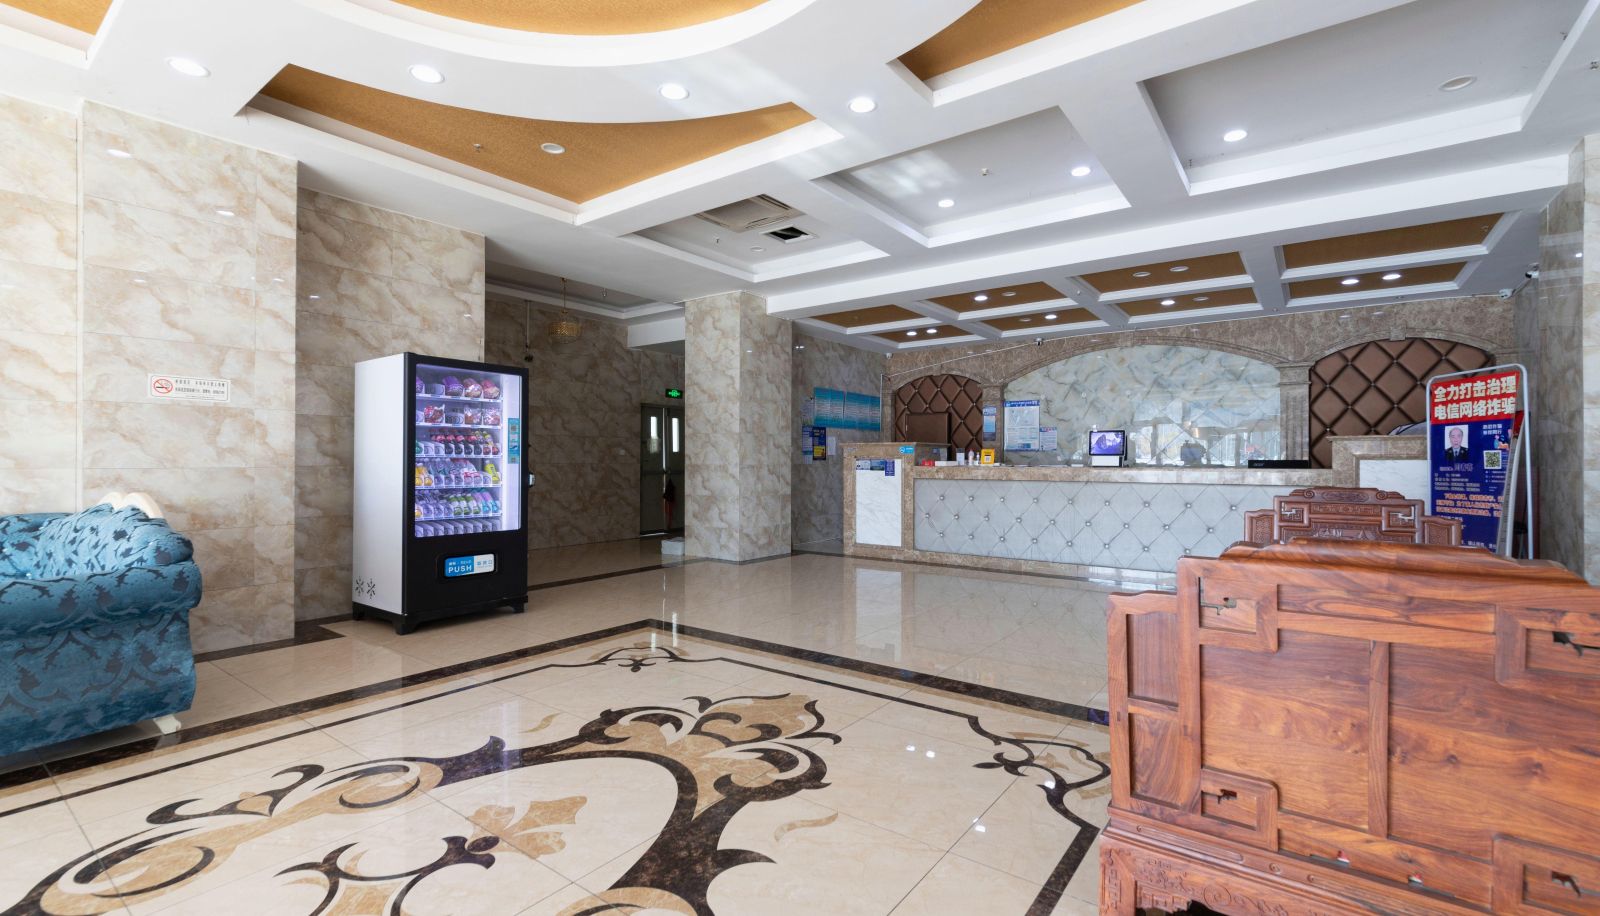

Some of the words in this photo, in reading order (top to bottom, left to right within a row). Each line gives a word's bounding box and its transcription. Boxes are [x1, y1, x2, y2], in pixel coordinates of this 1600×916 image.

[1434, 375, 1516, 402] 全力打击治理
[1434, 396, 1516, 420] 电信网络诈骗
[448, 565, 472, 574] PUSH
